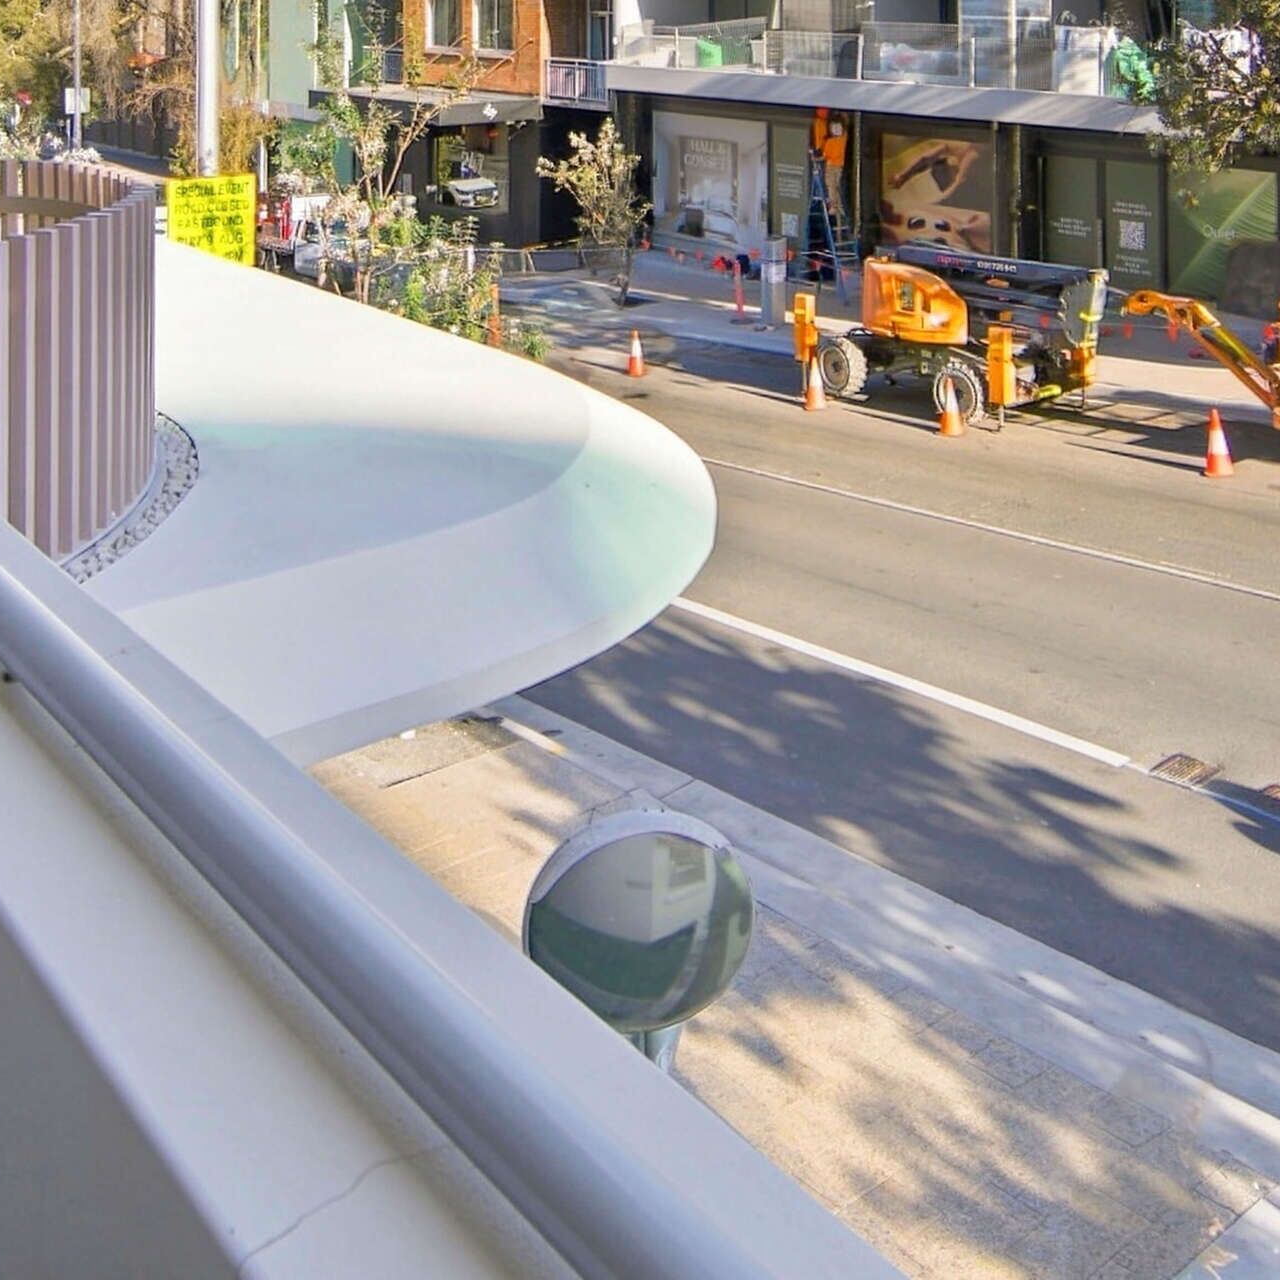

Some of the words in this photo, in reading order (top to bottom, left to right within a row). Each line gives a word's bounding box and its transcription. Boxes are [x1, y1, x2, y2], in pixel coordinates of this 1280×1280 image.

[175, 183, 216, 198] SPECIAL
[218, 181, 250, 195] EVENT
[207, 200, 250, 213] CLOSED
